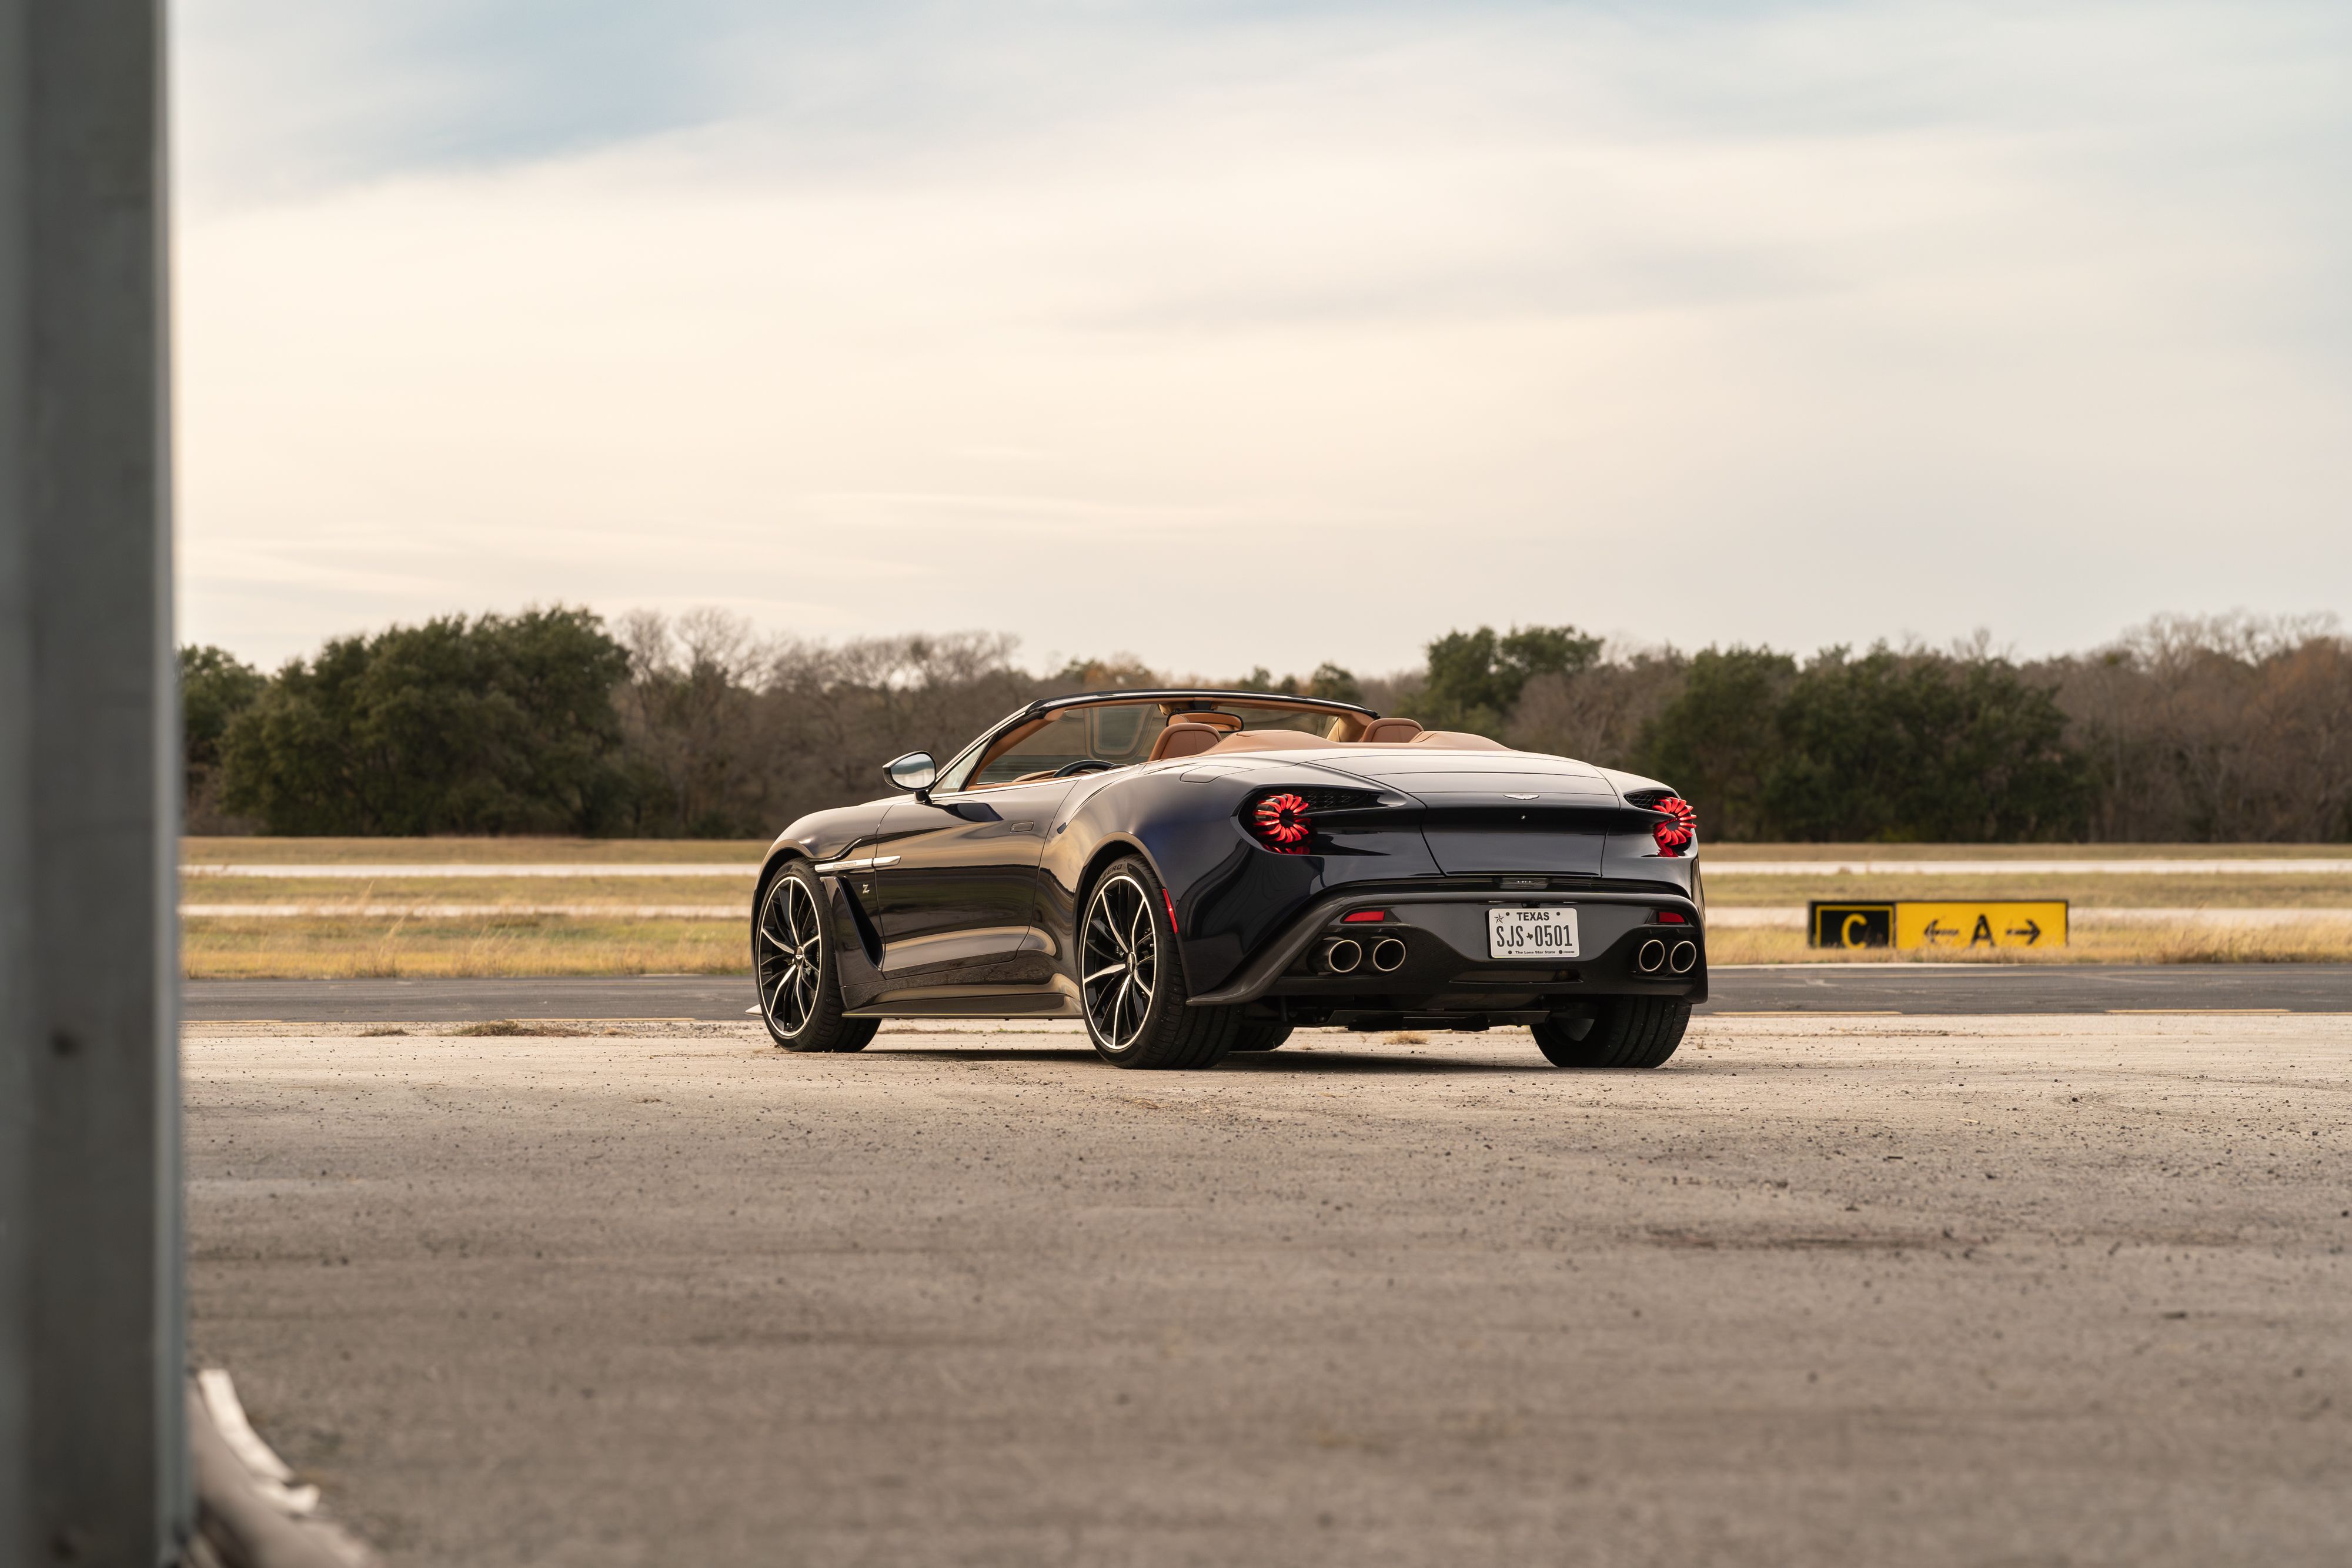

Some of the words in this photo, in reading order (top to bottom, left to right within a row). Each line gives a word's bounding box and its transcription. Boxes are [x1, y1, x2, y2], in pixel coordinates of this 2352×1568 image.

[1516, 912, 1549, 921] TEXAS
[1496, 925, 1524, 947] SJS
[1535, 925, 1572, 946] 0501
[1842, 913, 1867, 948] C
[1970, 914, 1995, 947] A
